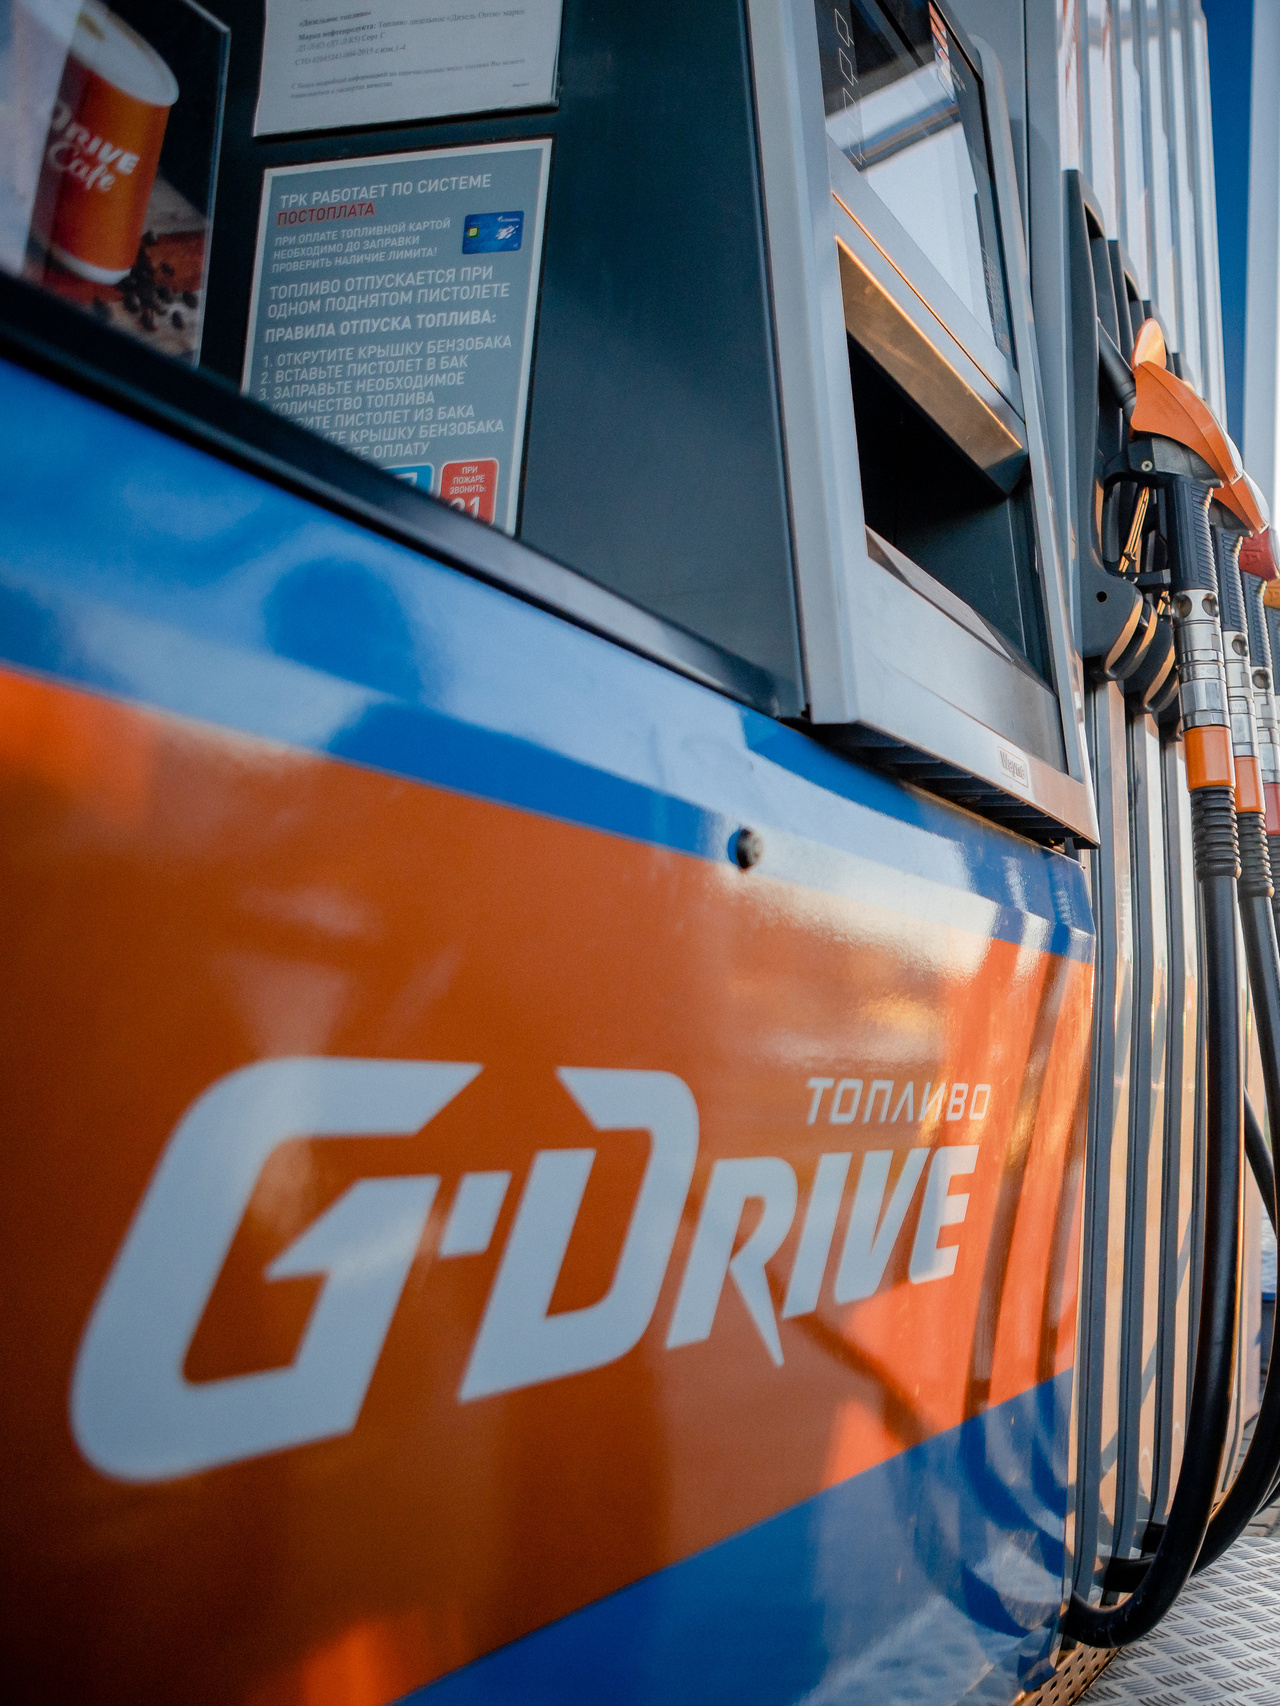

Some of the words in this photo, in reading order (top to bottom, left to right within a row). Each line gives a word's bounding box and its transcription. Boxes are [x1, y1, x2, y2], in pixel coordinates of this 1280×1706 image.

[280, 193, 308, 208] ТРК
[312, 184, 388, 205] РАБОТАЕТ
[392, 182, 412, 196] ПО
[417, 174, 492, 194] СИСТЕМЕ
[278, 202, 374, 225] ПОСТОПЛАТА
[274, 236, 296, 246] ПРИ
[298, 230, 338, 244] ОПЛАТЕ
[341, 221, 406, 239] ТОПЛИВНОЙ
[408, 218, 451, 232] КАРТОЙ
[272, 258, 332, 273] ПРОВЕРИТЬ
[334, 252, 386, 266] НАЛИЧИЕ
[388, 247, 438, 261] ЛИМИТА!
[273, 243, 344, 260] НЕОБХОДИМО
[344, 241, 360, 253] ДО
[363, 236, 420, 250] ЗАПРАВКИ
[270, 279, 340, 300] ТОПЛИВО
[344, 268, 456, 292] ОТПУСКАЕТСЯ
[460, 266, 494, 282] ПРИ
[268, 300, 321, 320] ОДНОМ
[325, 290, 413, 312] ПОДНЯТОМ
[417, 282, 510, 304] ПИСТОЛЕТЕ
[264, 322, 336, 344] ПРАВИЛА
[340, 316, 412, 336] ОТПУСКА
[416, 309, 496, 329] ТОПЛИВА:
[263, 355, 273, 368] 1.
[277, 348, 354, 367] ОТКРУТИТЕ
[358, 342, 424, 360] КРЫШКУ
[426, 334, 512, 354] БЕНЗОБАКА
[260, 372, 271, 384] 2.
[275, 364, 344, 384] ВСТАВЬТЕ
[347, 358, 423, 376] ПИСТОЛЕТ
[426, 357, 436, 371] В
[440, 354, 469, 370] БАК
[274, 380, 352, 400] ЗАПРАВЬТЕ
[356, 372, 466, 393] НЕОБХОДИМОЕ
[366, 390, 435, 408] ТОПЛИВА
[334, 409, 411, 427] ПИСТОЛЕТ
[414, 408, 434, 422] ИЗ
[438, 404, 475, 420] БАКА
[350, 426, 416, 444] КРЫШКУ
[419, 419, 504, 439] БЕНЗОБАКА
[373, 442, 430, 458] ОПЛАТУ
[453, 475, 485, 484] ПОЖАРЕ
[462, 466, 478, 474] ПРИ
[450, 486, 486, 495] ЗВОНИТЬ:
[1000, 750, 1025, 780] Wayne
[807, 1077, 992, 1125] ТОПЛИВО
